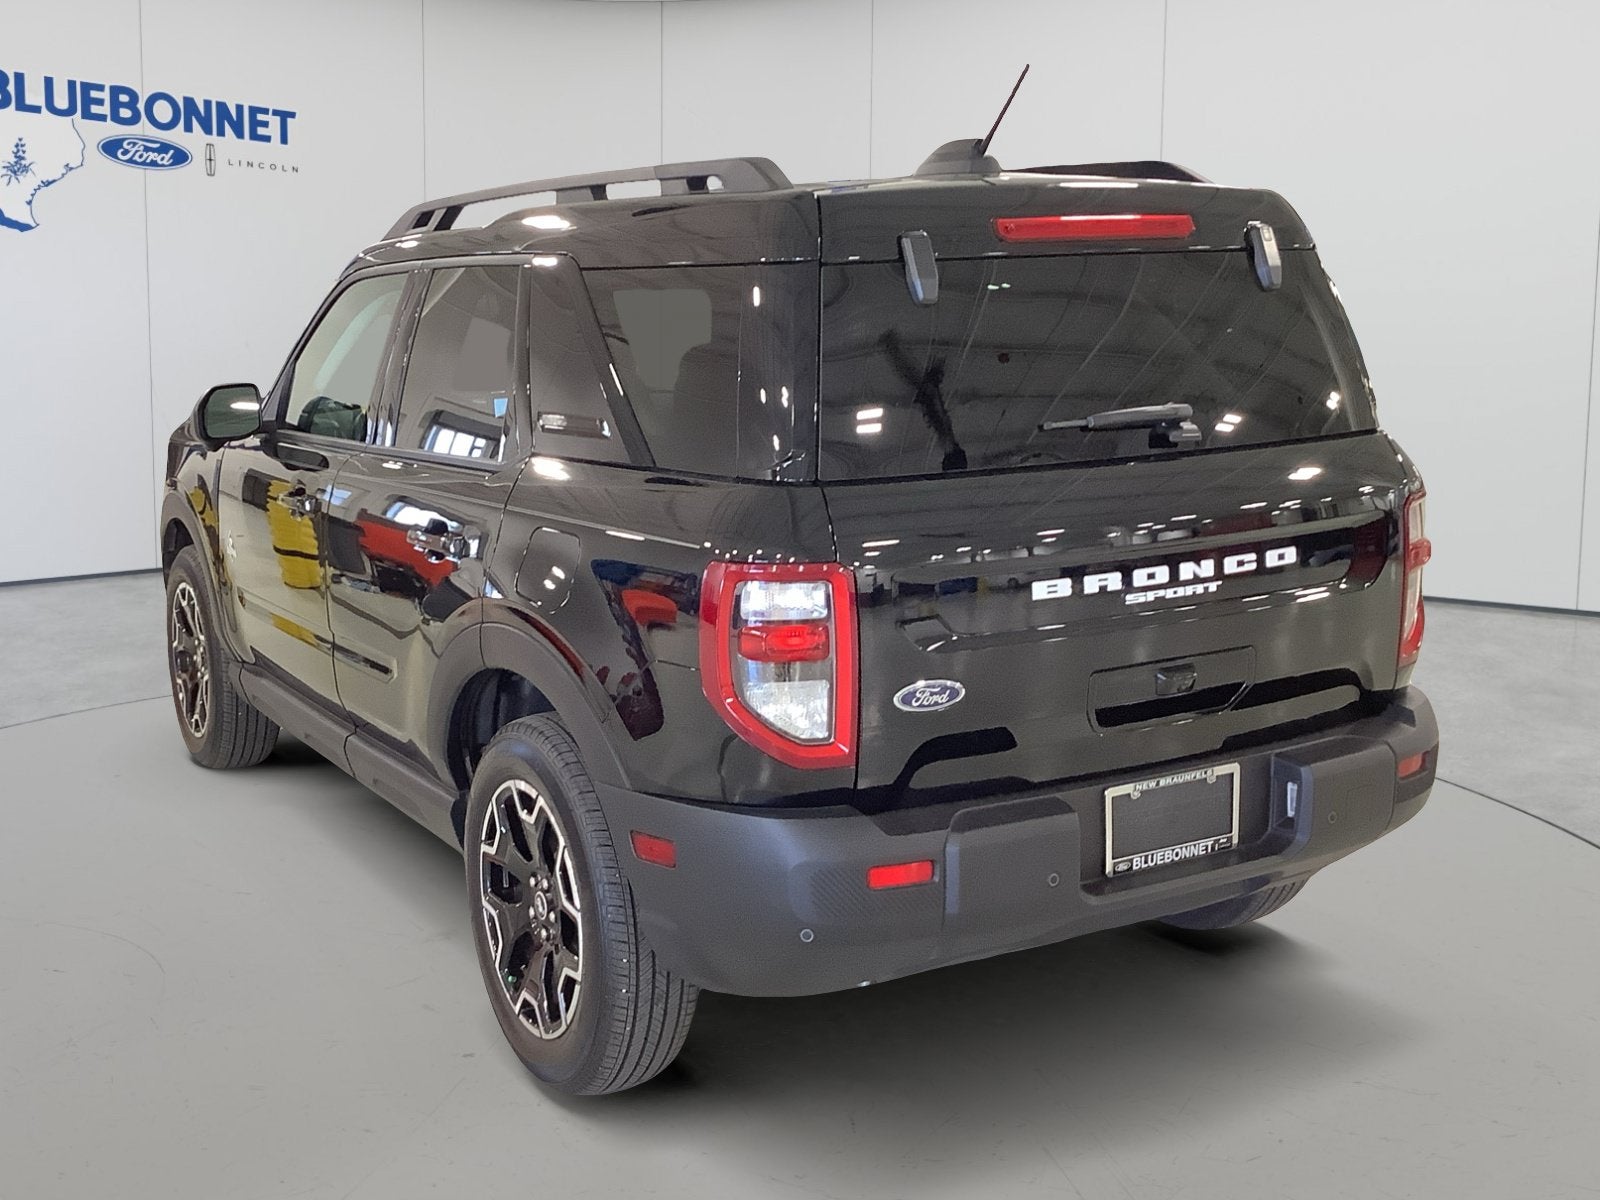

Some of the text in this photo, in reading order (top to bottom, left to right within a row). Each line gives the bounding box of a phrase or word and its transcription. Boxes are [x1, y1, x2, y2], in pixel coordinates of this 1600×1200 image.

[116, 138, 175, 167] Ford
[227, 159, 299, 173] LINCOLN
[1031, 545, 1298, 601] BRONCO
[1124, 580, 1223, 605] SPORT
[911, 687, 951, 707] Ford
[1135, 780, 1157, 791] NEW
[1132, 840, 1215, 871] BLUEBONNET
